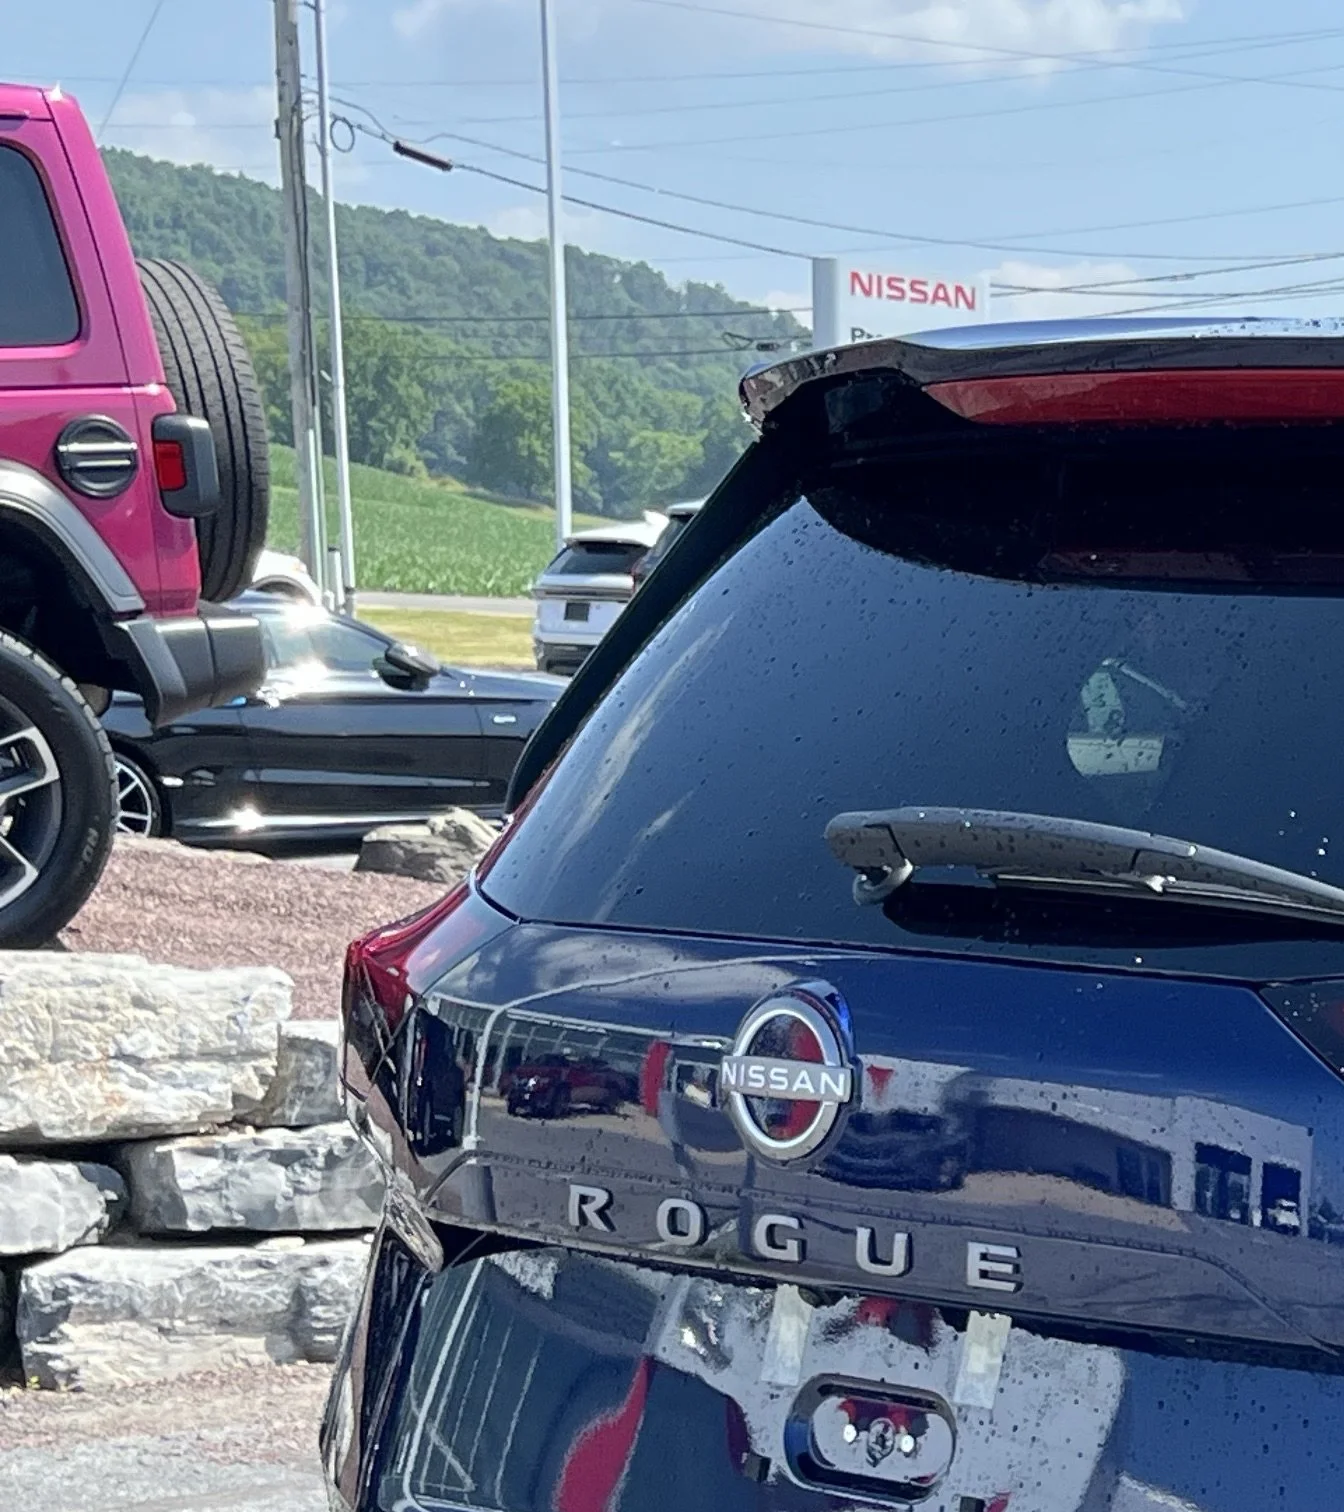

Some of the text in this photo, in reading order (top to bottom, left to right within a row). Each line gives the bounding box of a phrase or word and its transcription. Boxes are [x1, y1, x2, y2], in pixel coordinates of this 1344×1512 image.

[850, 271, 976, 311] NISSAN
[721, 1062, 848, 1097] NISSAN
[568, 1184, 1021, 1292] ROGUE
